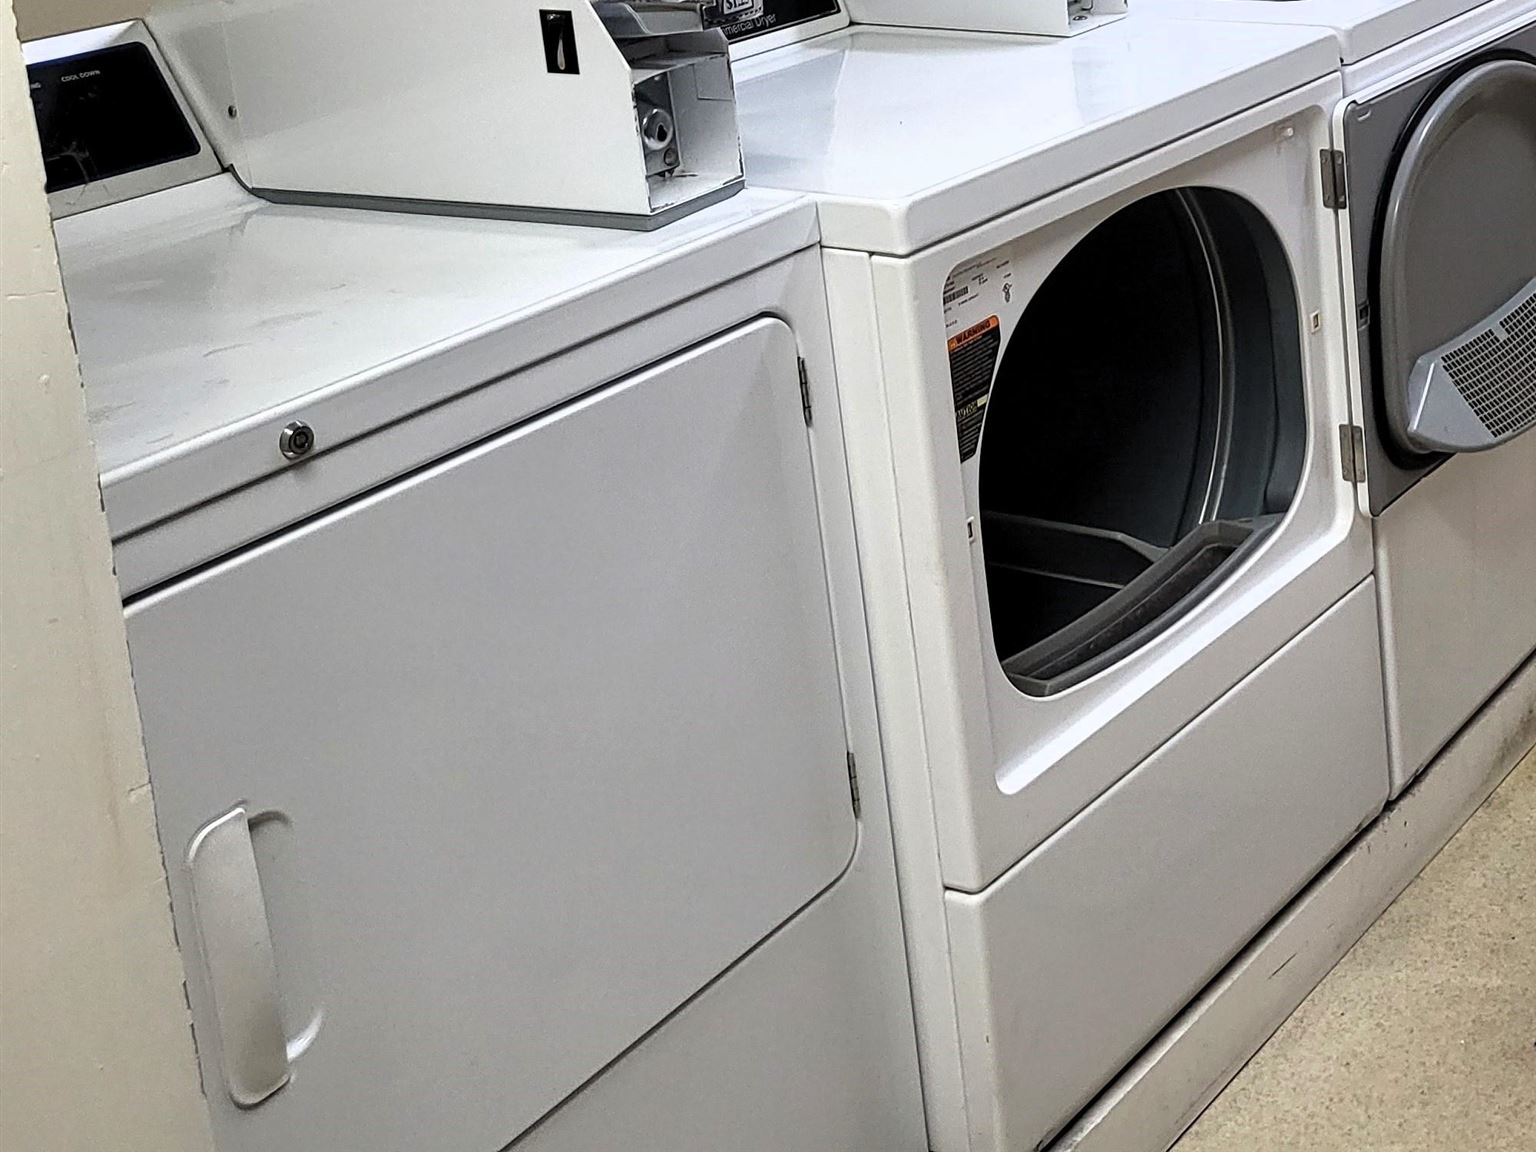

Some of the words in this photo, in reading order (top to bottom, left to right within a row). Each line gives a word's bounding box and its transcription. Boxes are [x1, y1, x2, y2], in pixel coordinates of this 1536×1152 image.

[754, 14, 776, 26] Dryer
[61, 74, 78, 82] COOL
[80, 70, 100, 78] DOWN
[955, 319, 990, 344] WARNING
